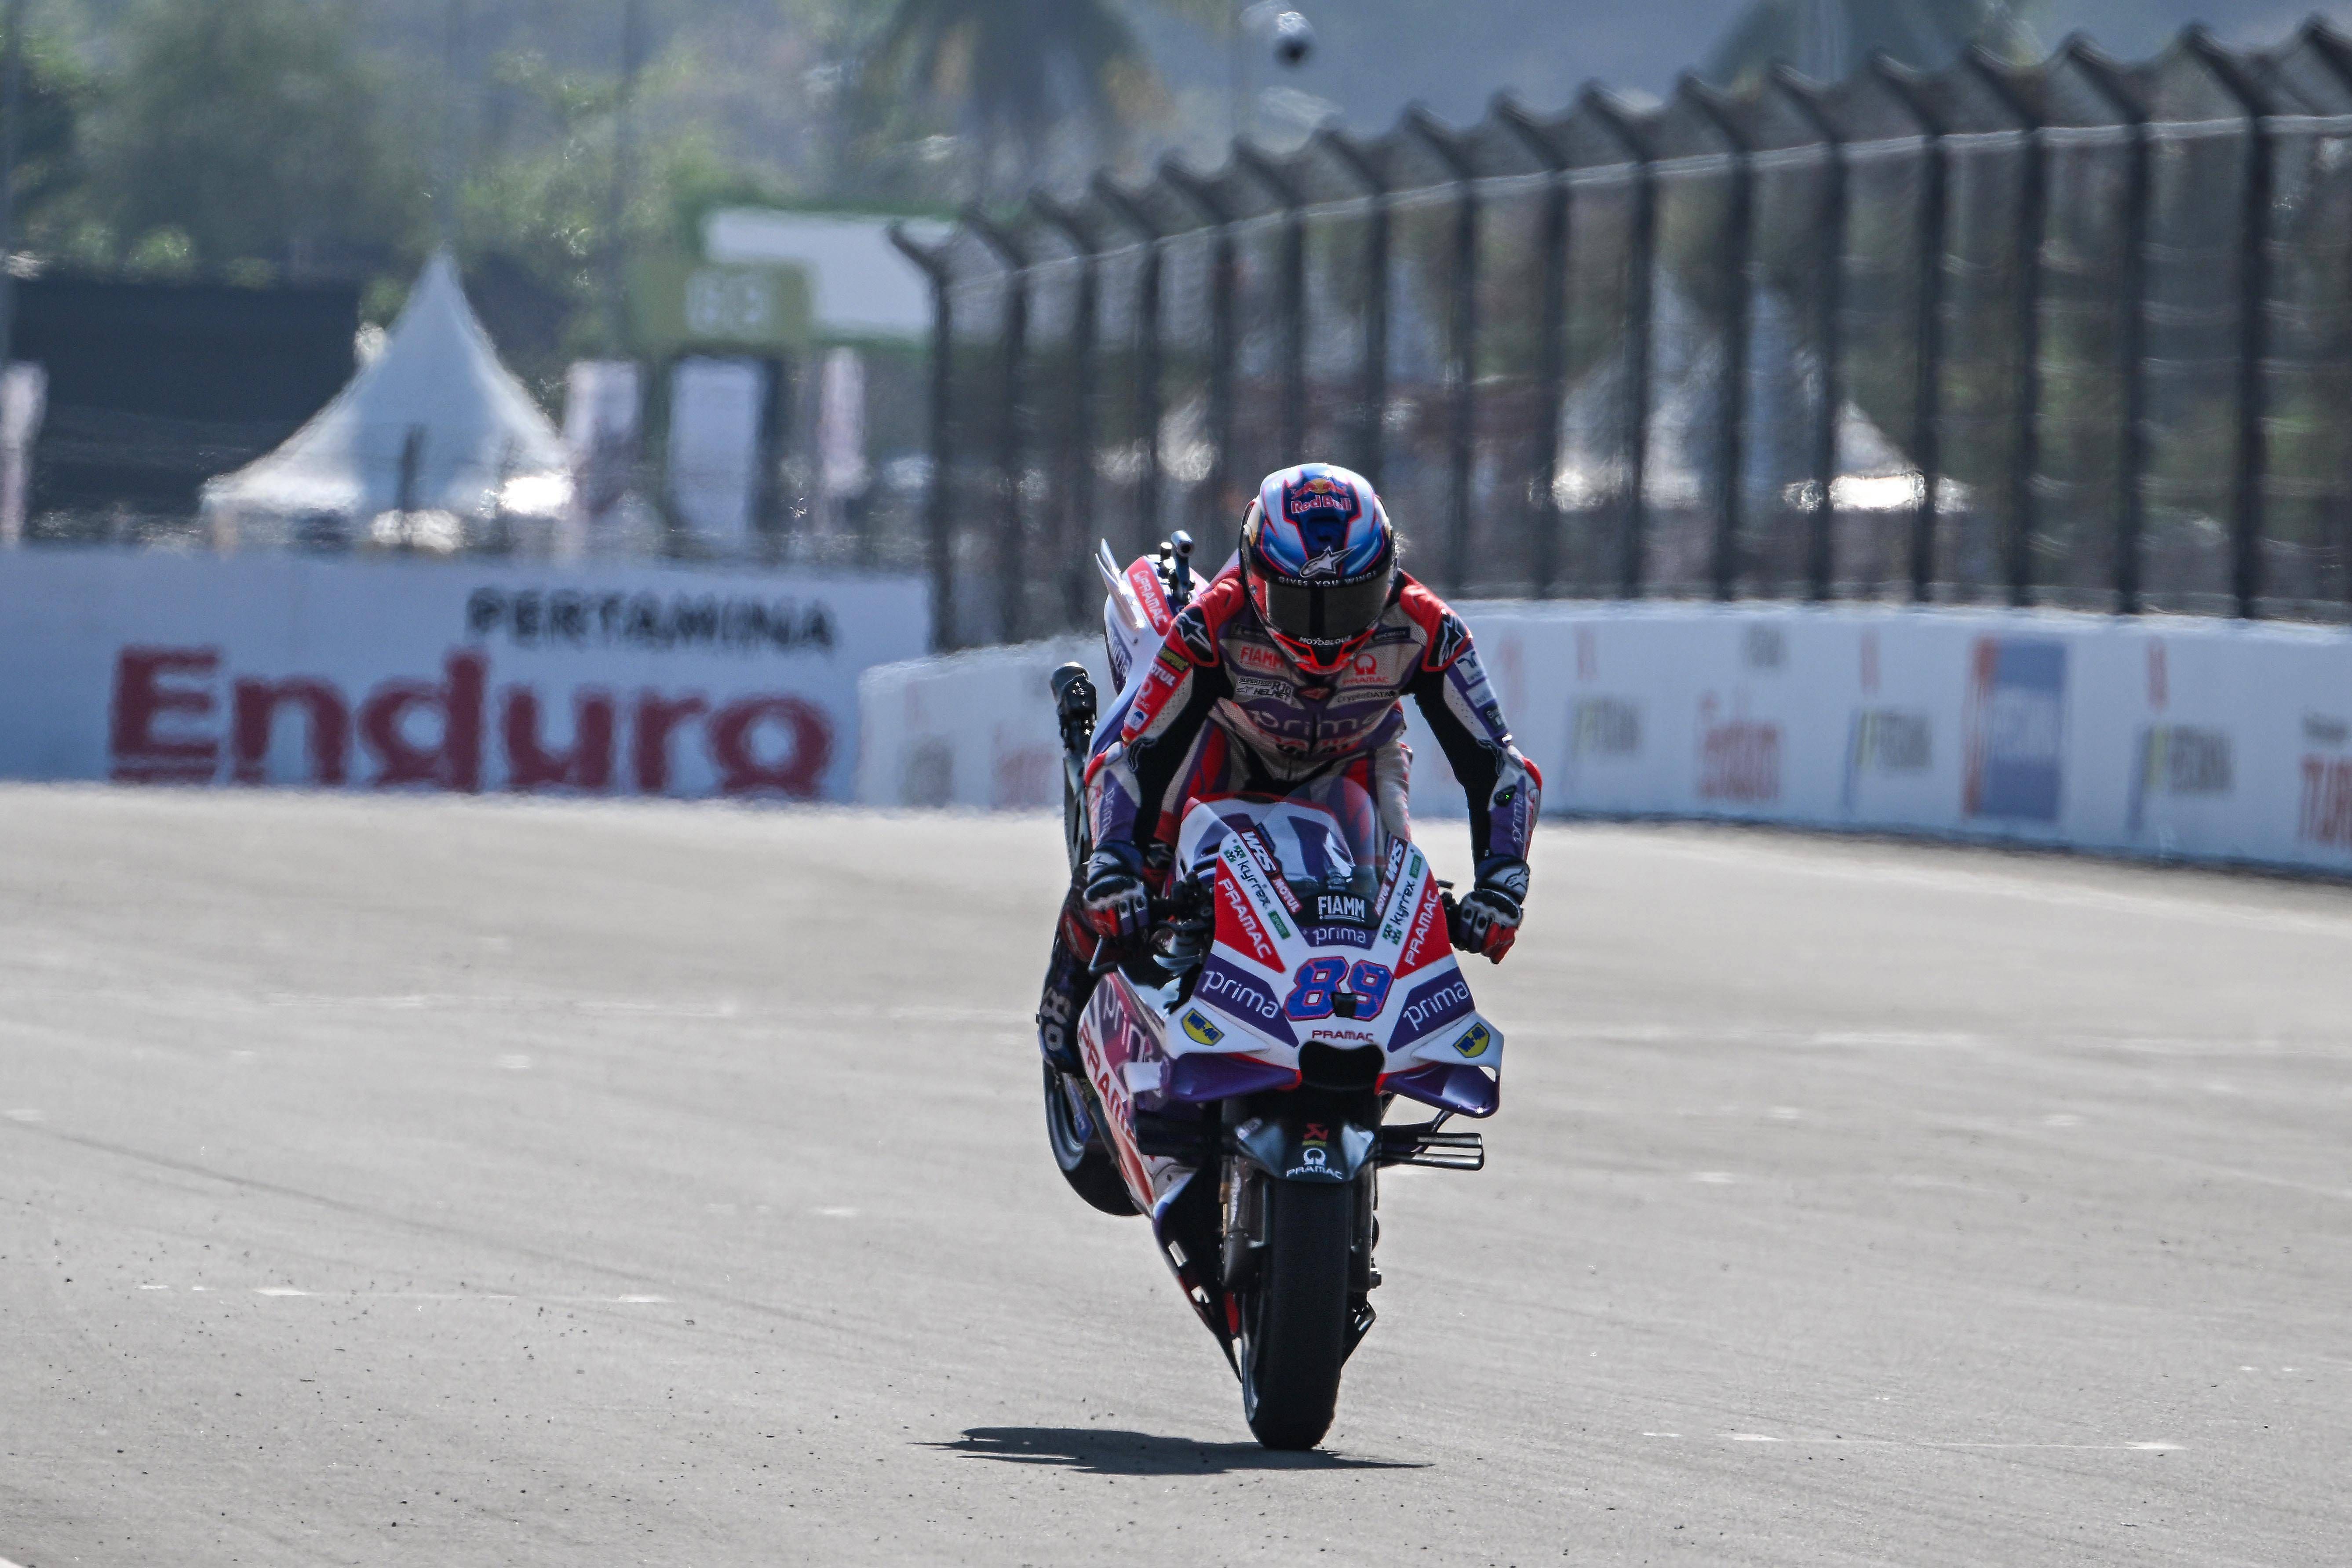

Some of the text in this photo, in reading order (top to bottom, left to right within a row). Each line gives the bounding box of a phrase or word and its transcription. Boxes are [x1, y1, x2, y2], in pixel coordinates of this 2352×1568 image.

[1291, 495, 1351, 514] Red Bull
[1278, 576, 1308, 586] GIVES
[1315, 578, 1339, 587] YOU
[468, 586, 834, 651] PERTAMINA
[1139, 578, 1169, 628] PRAMAC
[1149, 661, 1177, 687] OTUL
[1342, 676, 1389, 685] PRAMAC
[111, 644, 834, 777] Enduro
[1273, 878, 1300, 913] MOTUL
[1317, 895, 1365, 919] FIAMM
[1218, 878, 1272, 959] PRAMAC
[1313, 927, 1366, 945] prima
[1405, 890, 1438, 967] PRAMAC
[1202, 970, 1279, 1019] prima
[1283, 956, 1394, 1022] 89
[1403, 981, 1470, 1031] prima
[1312, 1030, 1374, 1042] PRAMAC
[1286, 1165, 1343, 1180] PRAMAC
